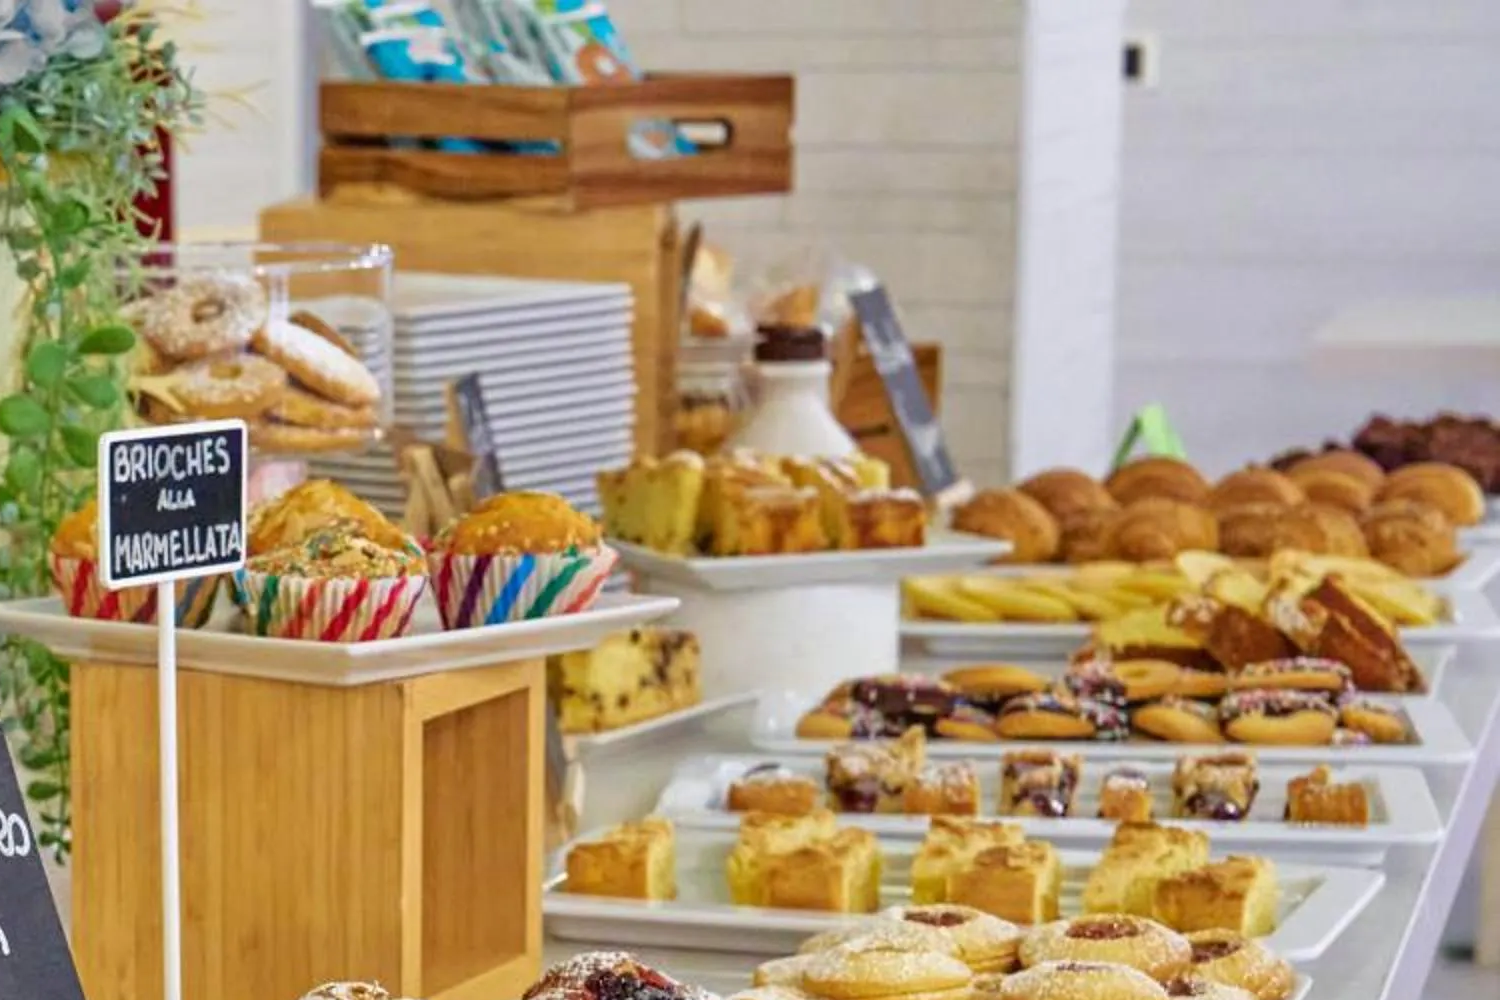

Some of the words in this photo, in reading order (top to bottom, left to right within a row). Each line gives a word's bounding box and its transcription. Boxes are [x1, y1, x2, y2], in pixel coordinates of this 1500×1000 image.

[113, 437, 231, 484] BRIOCHES
[157, 487, 197, 512] ALLA
[114, 519, 242, 574] MARMELLATA
